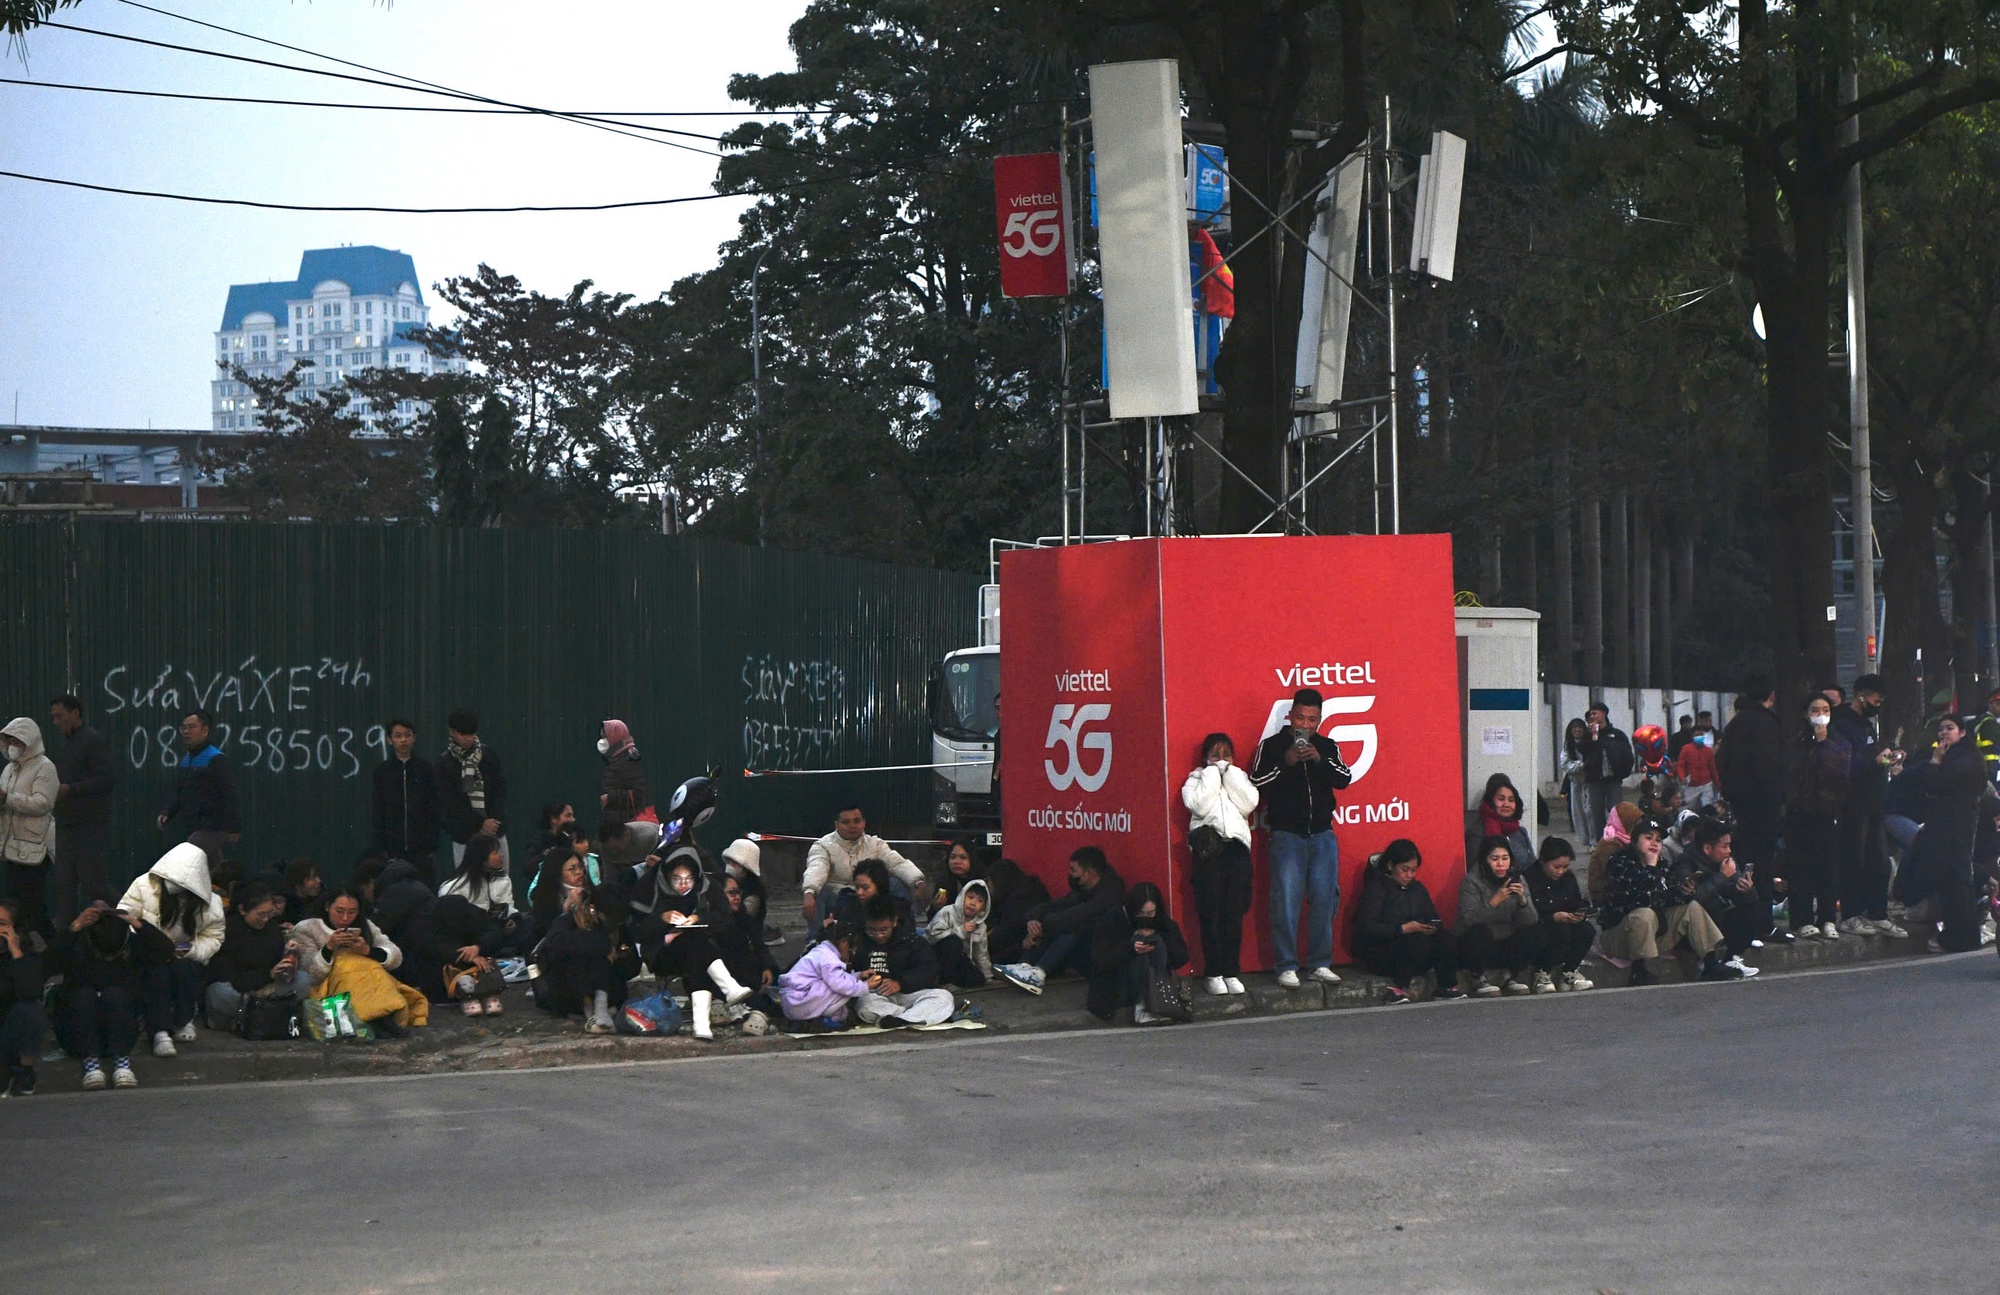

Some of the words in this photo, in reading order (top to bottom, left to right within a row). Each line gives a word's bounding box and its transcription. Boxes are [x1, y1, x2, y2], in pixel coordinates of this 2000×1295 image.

[1010, 192, 1058, 207] viettel
[1003, 209, 1060, 258] 5G
[1055, 669, 1112, 693] viettel
[1276, 662, 1376, 687] viettel
[1045, 704, 1112, 792] 5G
[1028, 808, 1063, 832] CUỘC
[1065, 801, 1103, 831] SỐNG
[1105, 811, 1132, 834] MỚI
[1332, 805, 1361, 825] NG
[1365, 796, 1409, 824] MỚI
